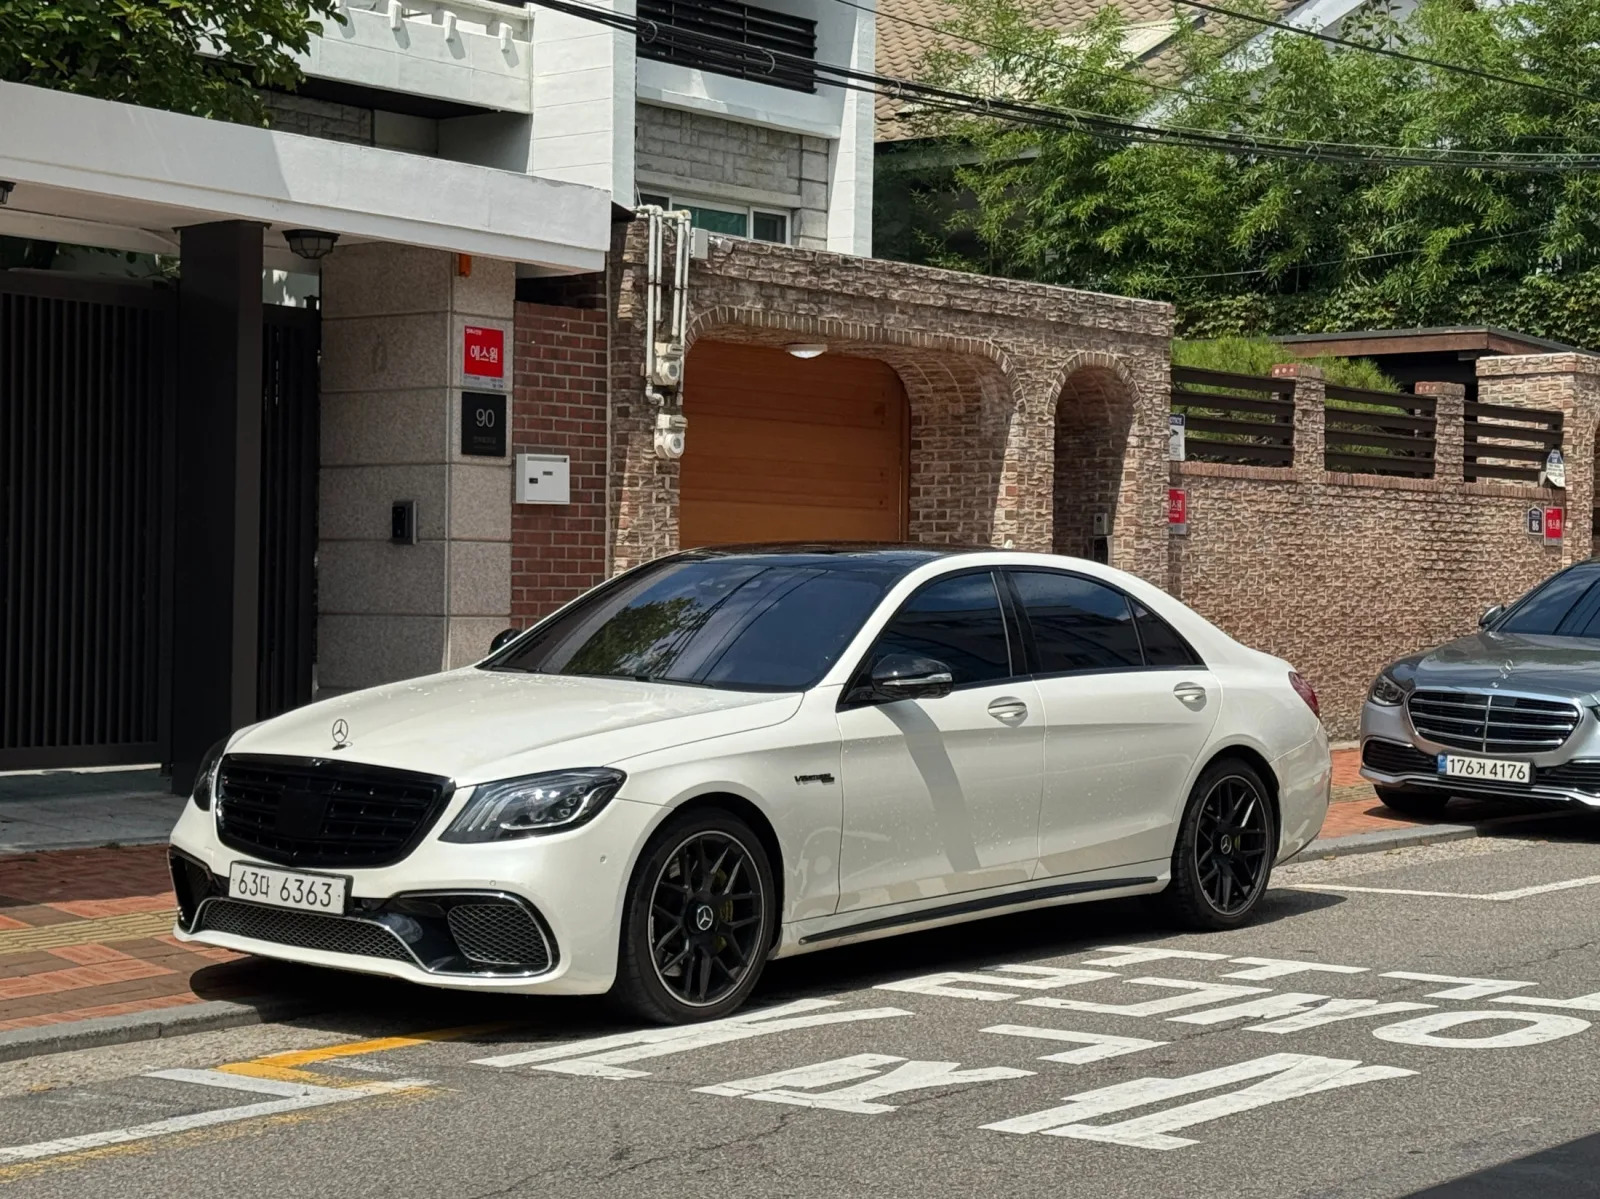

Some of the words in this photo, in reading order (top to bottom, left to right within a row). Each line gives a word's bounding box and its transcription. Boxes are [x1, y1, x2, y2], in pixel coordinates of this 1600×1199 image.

[470, 344, 498, 363] 에스원
[476, 408, 495, 428] 90
[1531, 520, 1540, 531] 86
[1449, 758, 1486, 776] 176거
[1489, 762, 1526, 780] 4176
[238, 870, 270, 898] 63다
[279, 877, 332, 907] 6363
